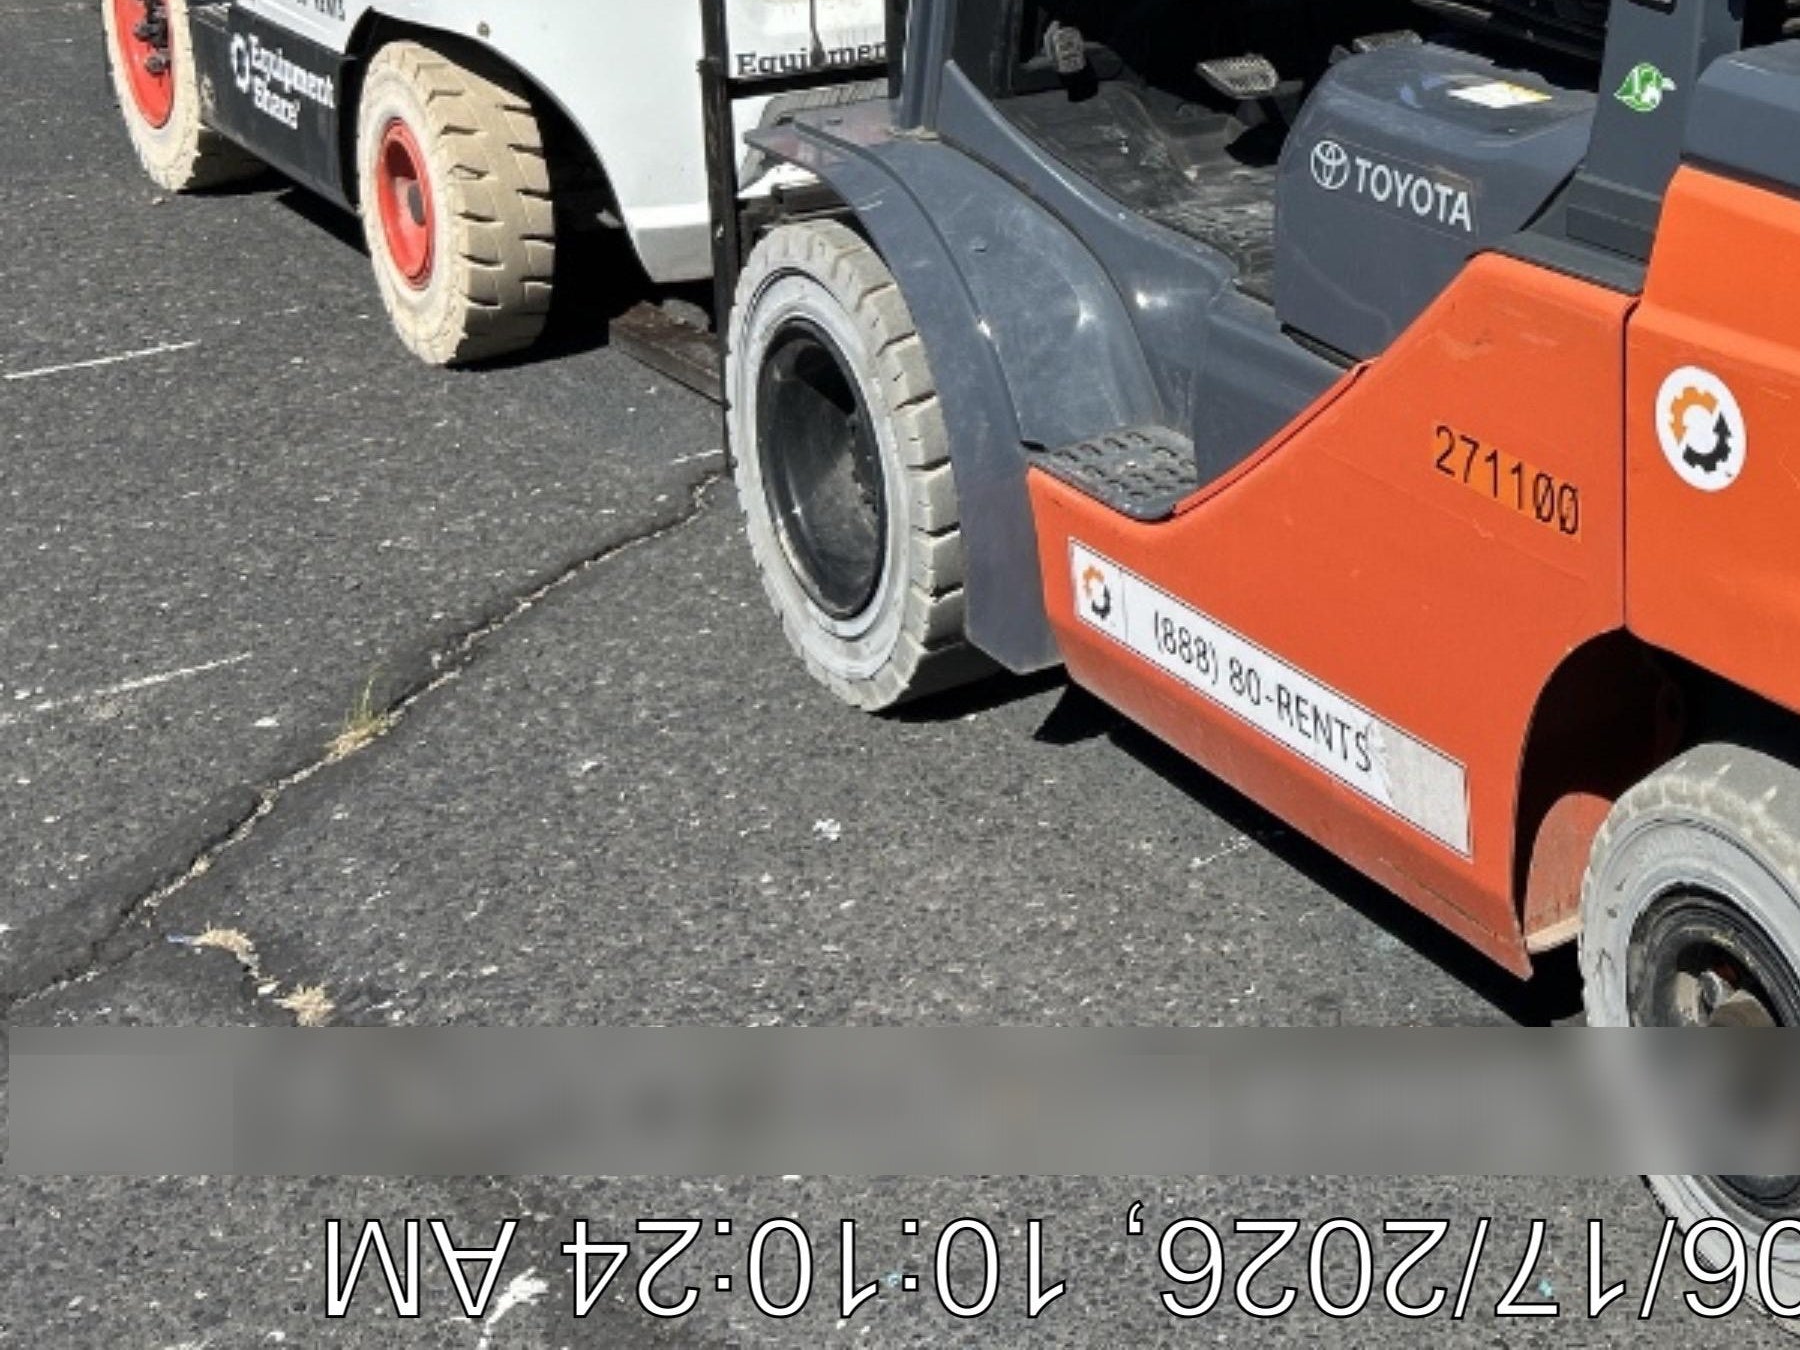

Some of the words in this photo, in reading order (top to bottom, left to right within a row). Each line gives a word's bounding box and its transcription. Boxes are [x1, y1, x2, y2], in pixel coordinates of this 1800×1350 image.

[247, 32, 336, 110] Equipment
[1354, 156, 1472, 232] TOYOTA
[1434, 424, 1579, 535] 271100
[1153, 610, 1220, 685] (888)
[1228, 656, 1374, 774] 80-RENTS
